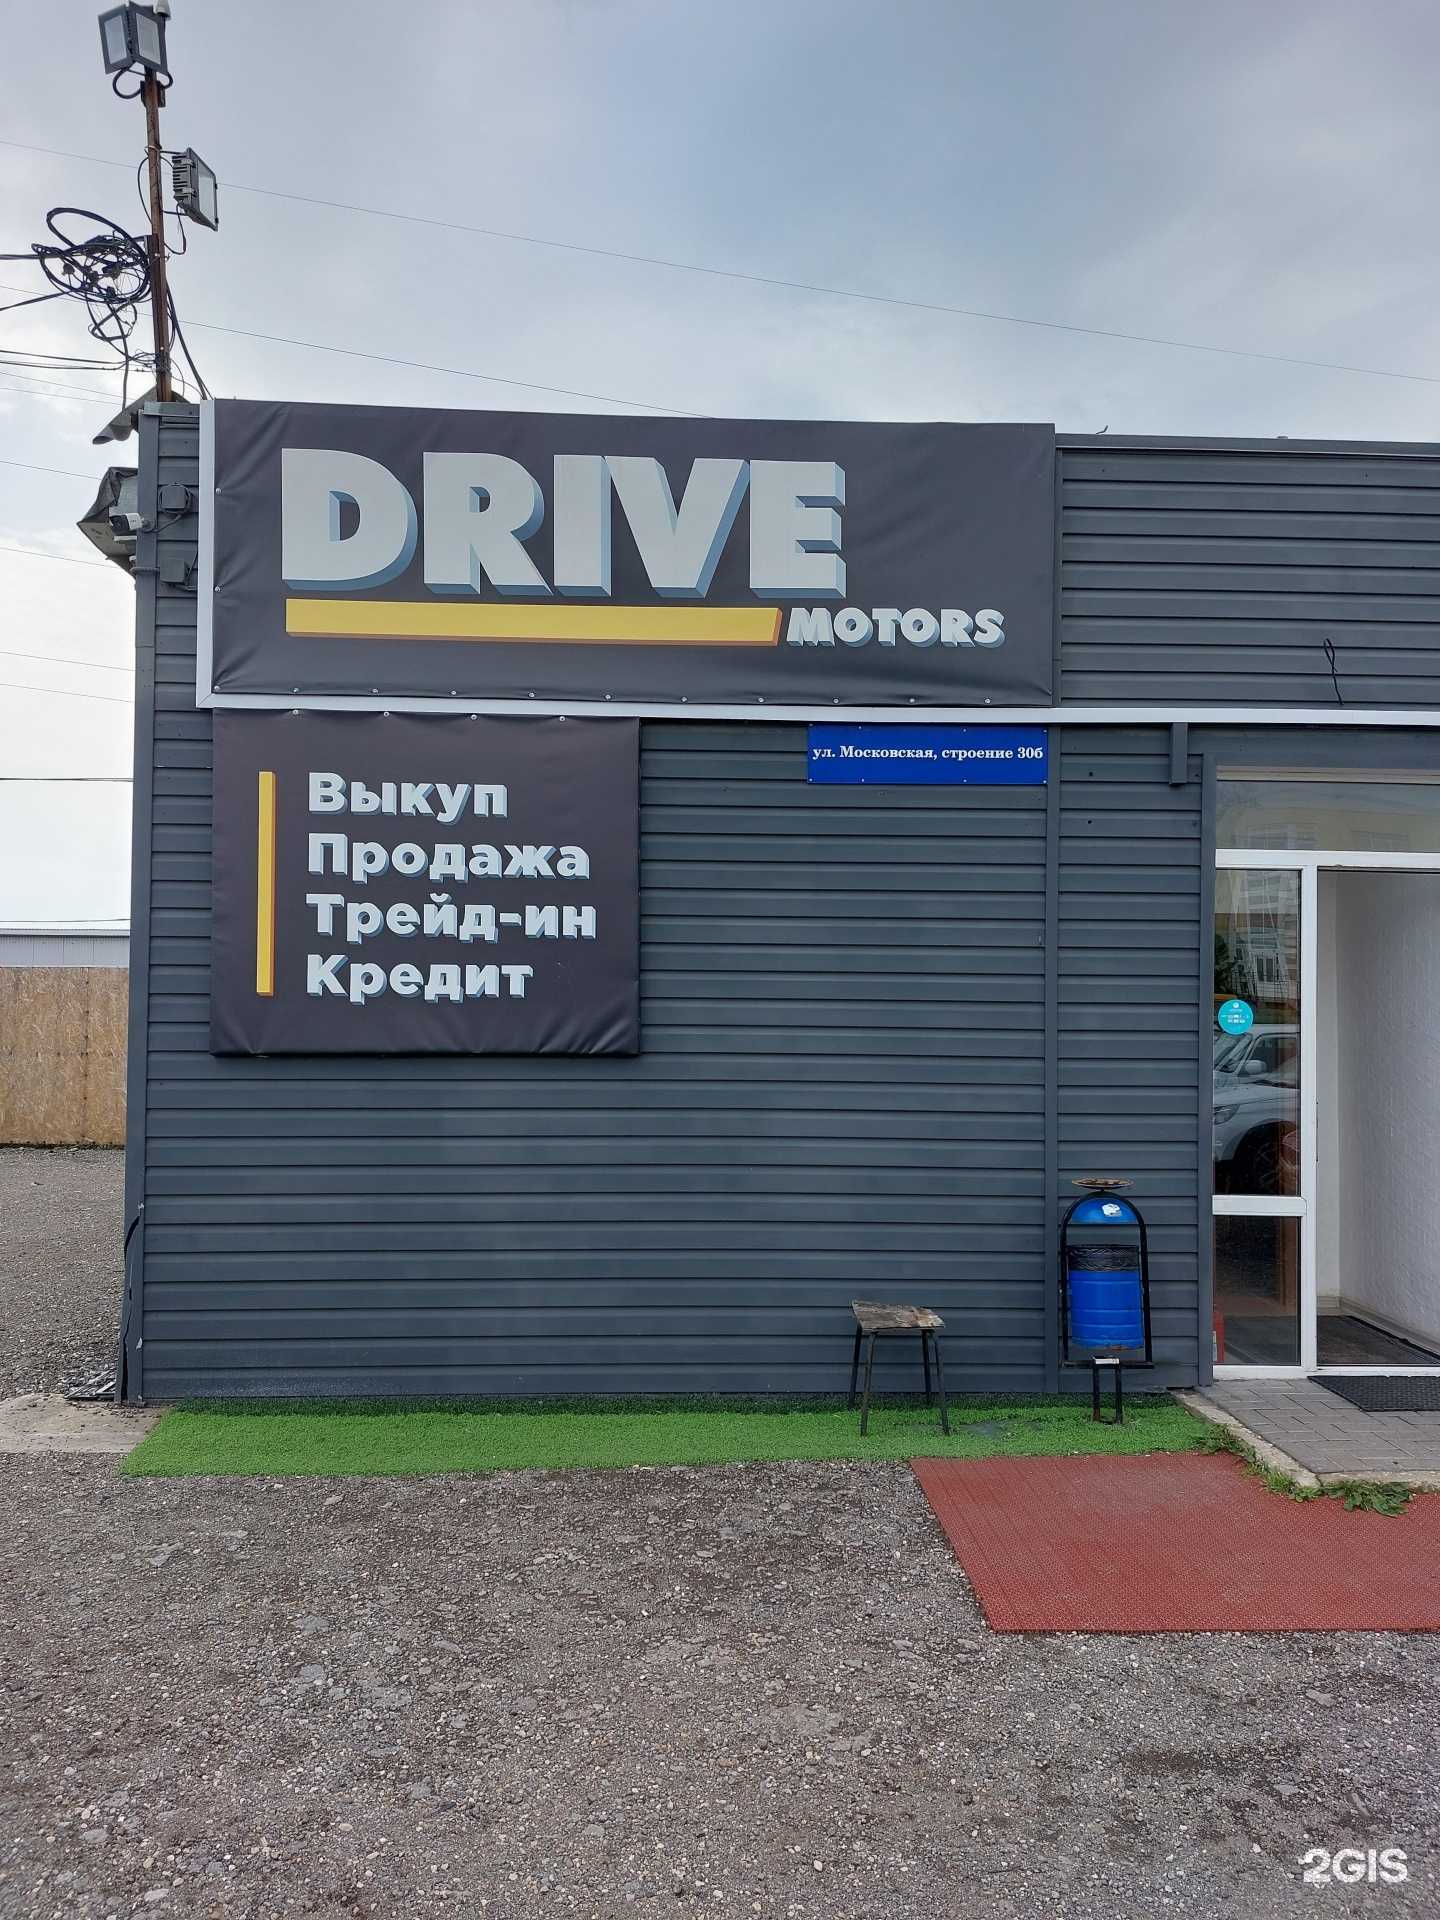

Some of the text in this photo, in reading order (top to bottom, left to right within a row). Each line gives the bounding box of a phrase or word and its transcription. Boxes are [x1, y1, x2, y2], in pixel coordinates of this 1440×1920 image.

[281, 448, 847, 598] DRIVE
[786, 606, 1005, 647] MOTORS
[812, 748, 835, 760] ул.
[839, 745, 938, 760] Московская,
[941, 749, 1014, 761] строение
[308, 772, 508, 825] Выкуп
[308, 832, 591, 884] Продажа
[305, 892, 598, 945] Трейд-ин
[305, 953, 534, 1006] Кредит
